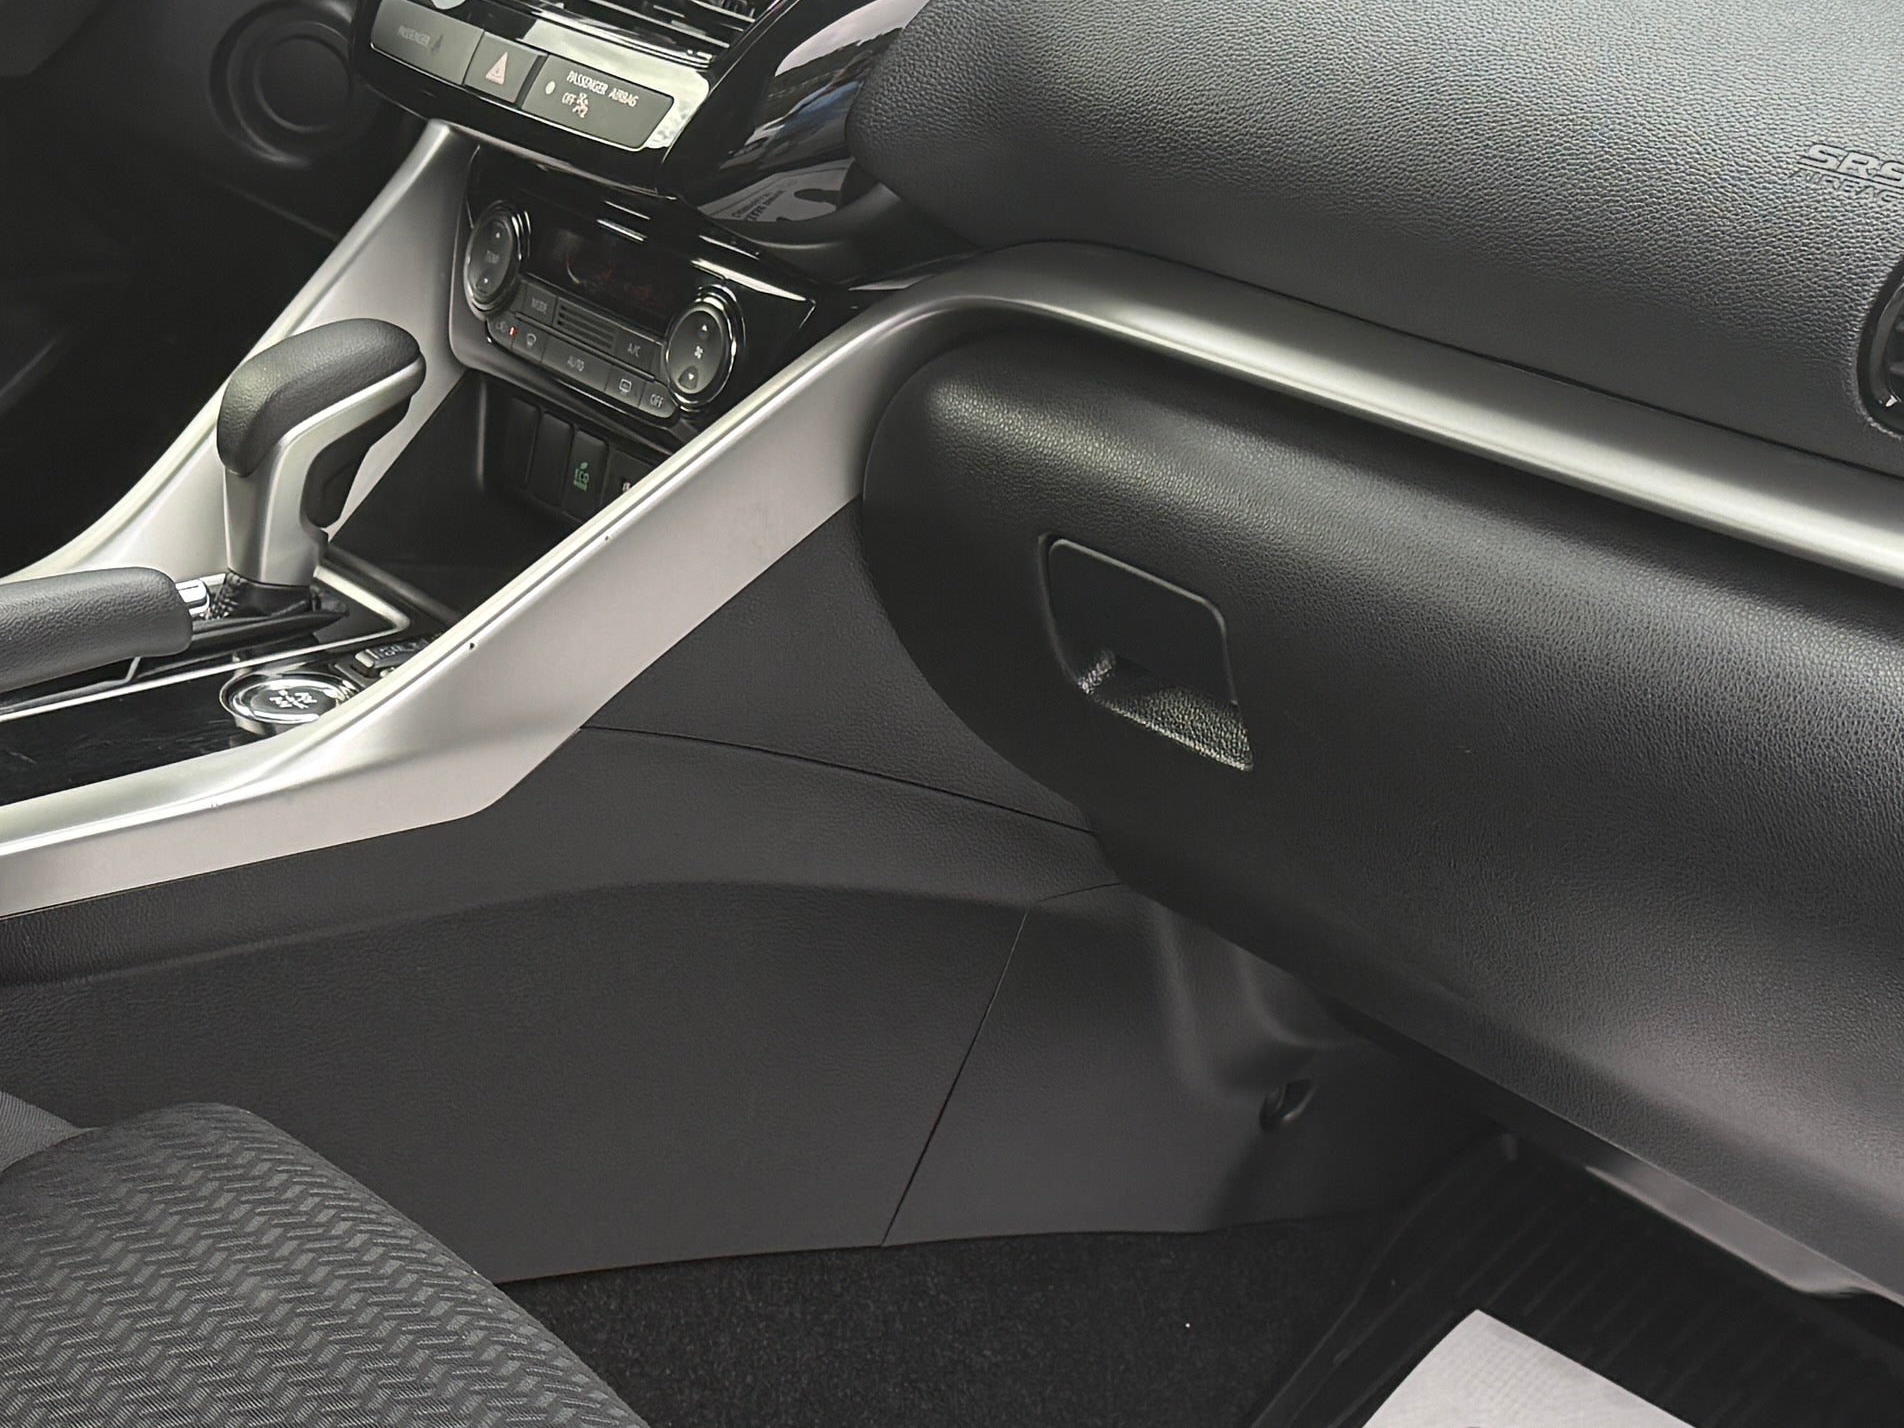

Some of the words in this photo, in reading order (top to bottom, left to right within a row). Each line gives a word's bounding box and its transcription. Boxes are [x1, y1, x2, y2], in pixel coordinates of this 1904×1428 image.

[562, 92, 578, 105] OFF
[566, 70, 609, 95] PASSENGER
[608, 88, 640, 108] AIRBAG
